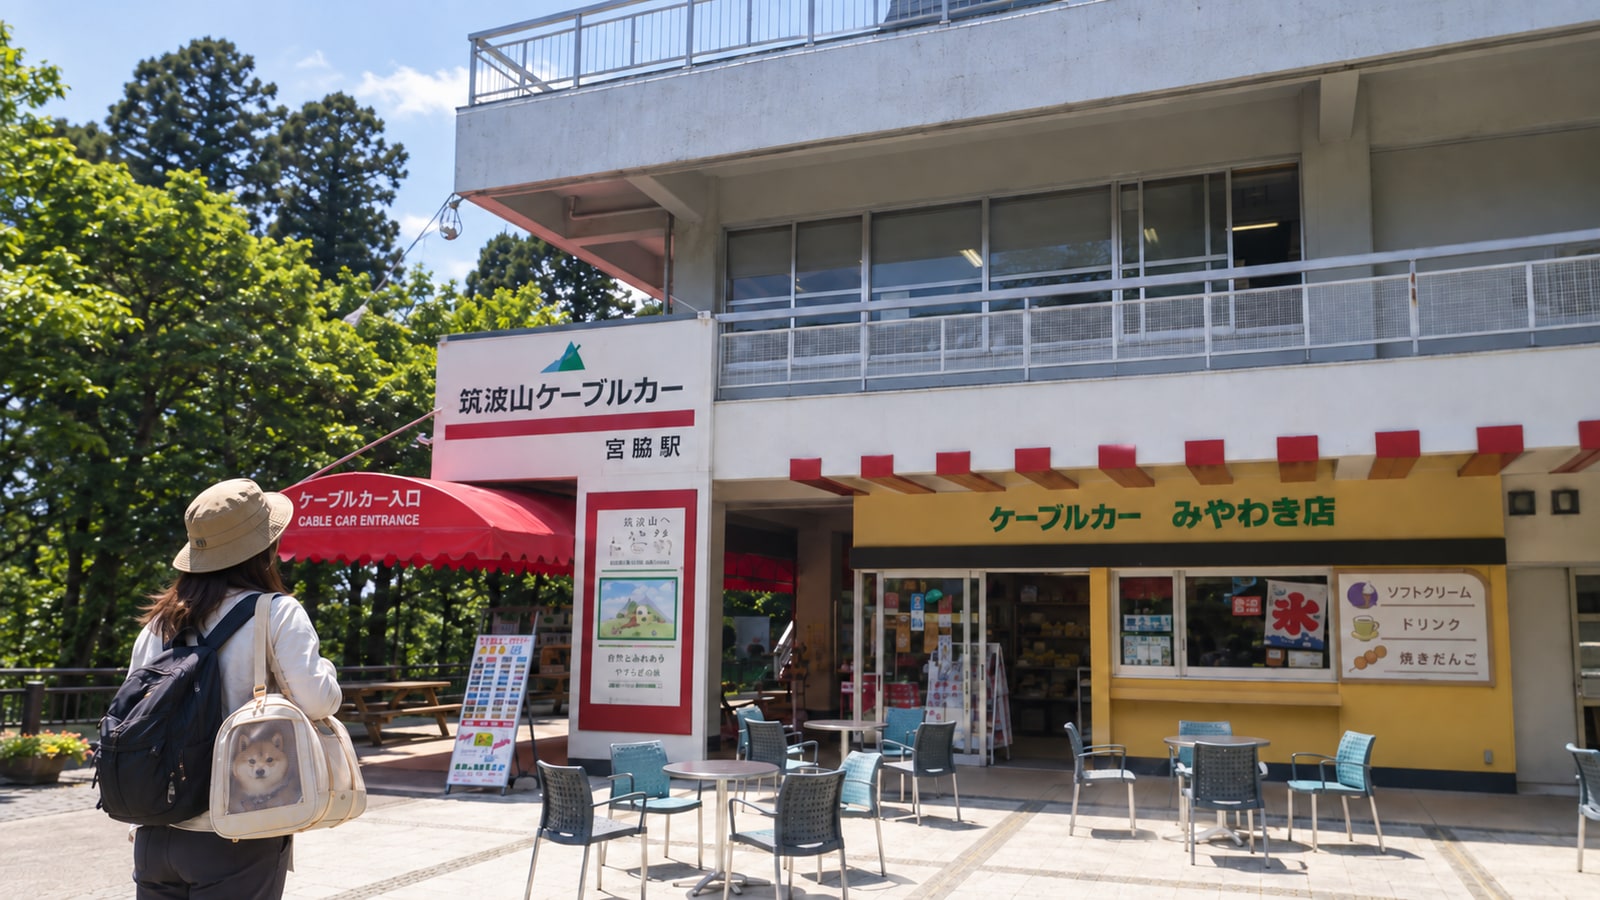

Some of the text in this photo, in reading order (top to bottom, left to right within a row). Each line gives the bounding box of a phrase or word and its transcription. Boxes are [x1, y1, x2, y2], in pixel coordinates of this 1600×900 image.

[458, 376, 684, 415] 筑波山ケーブルカー
[298, 489, 421, 509] ケーブルカー入口
[298, 513, 420, 527] CABLE CAR ENTRANCE
[989, 496, 1336, 532] ケーブルカー みやわき店
[1388, 586, 1472, 599] ソフトクリーム
[1272, 592, 1319, 635] 氷
[1403, 618, 1460, 631] ドリンク
[1400, 652, 1477, 666] 焼きだんご
